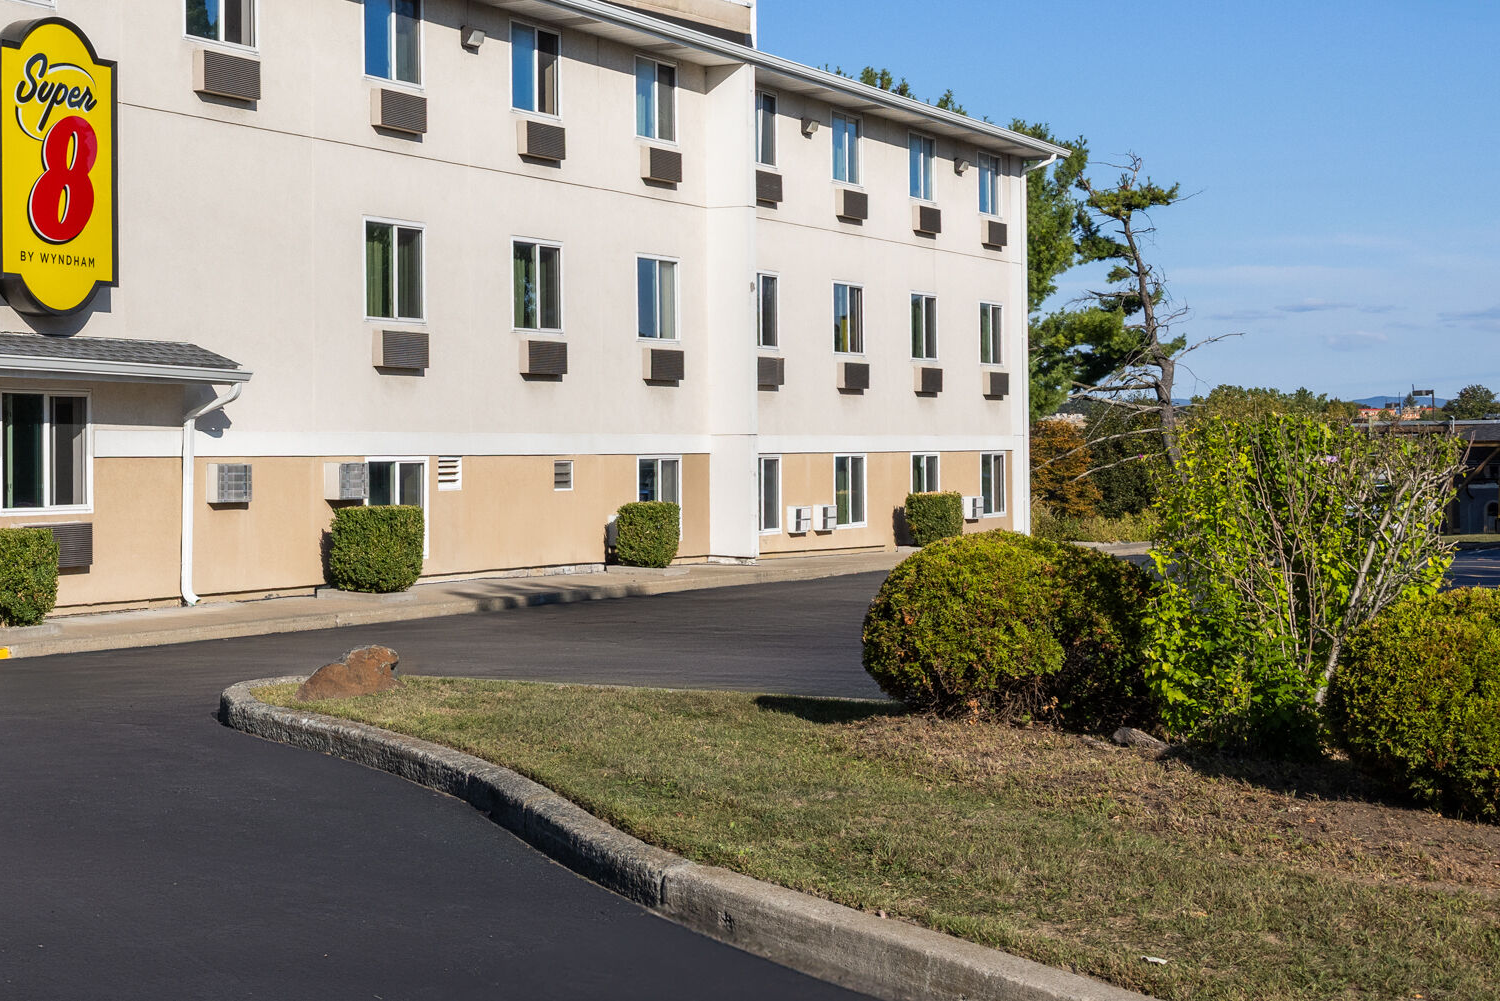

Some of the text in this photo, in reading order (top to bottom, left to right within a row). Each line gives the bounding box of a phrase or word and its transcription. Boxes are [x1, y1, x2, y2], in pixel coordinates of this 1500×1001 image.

[15, 53, 97, 132] Super
[27, 116, 98, 245] 8
[20, 250, 95, 268] BY WYNDHAM
